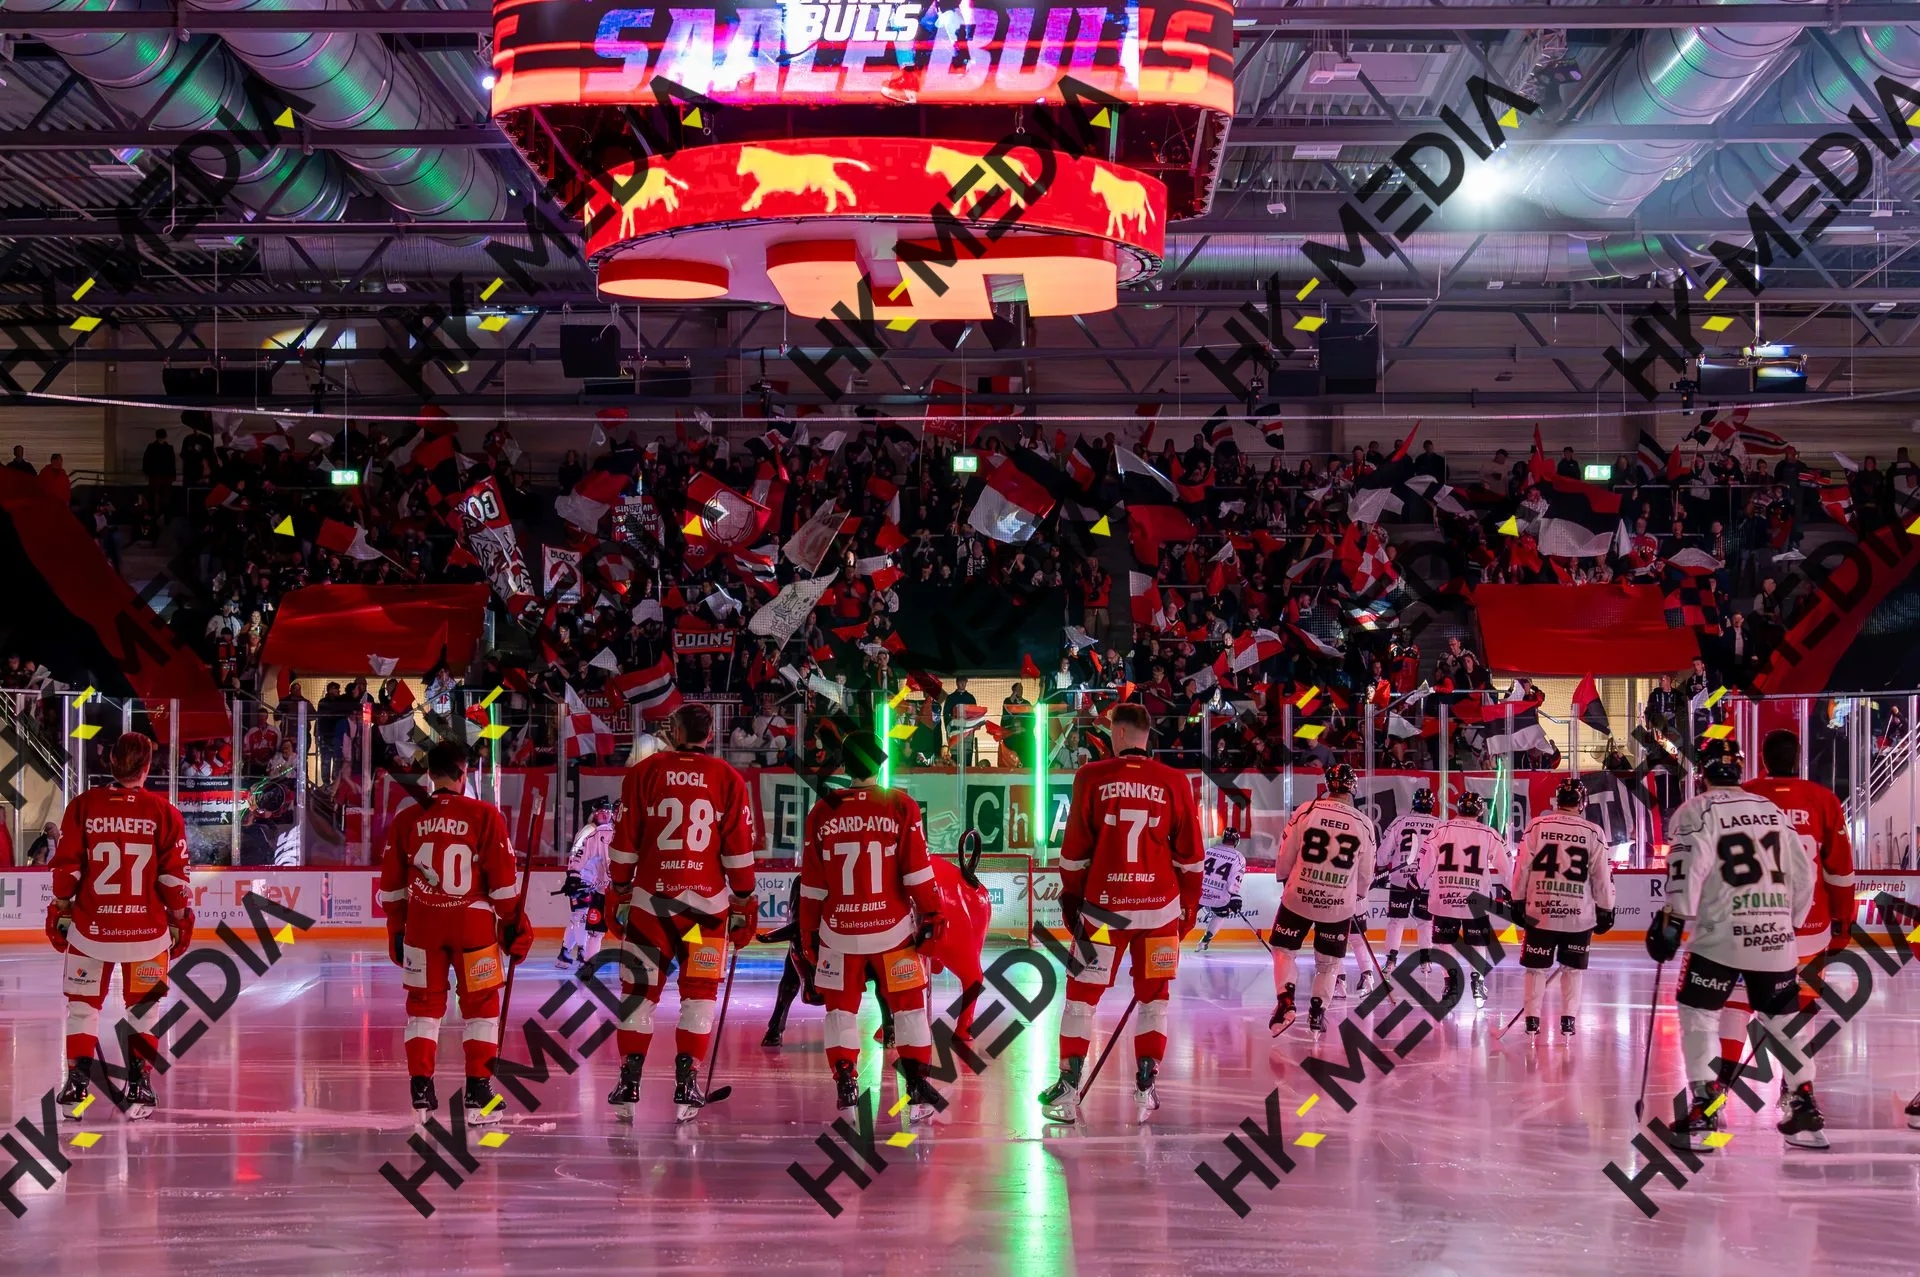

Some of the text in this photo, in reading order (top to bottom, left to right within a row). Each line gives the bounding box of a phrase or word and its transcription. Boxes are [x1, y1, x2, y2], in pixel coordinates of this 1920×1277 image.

[800, 4, 922, 41] BULLS
[675, 631, 733, 648] GOONS
[666, 771, 708, 788] ROGL
[1098, 782, 1167, 804] ZERNIKEL
[416, 817, 469, 837] HUARD
[656, 797, 714, 852] 28
[1320, 818, 1350, 831] REED
[1720, 814, 1779, 829] LAGACE
[1119, 808, 1149, 863] 7
[1541, 831, 1587, 844] HERZOG
[1301, 827, 1361, 870] 83
[92, 841, 153, 896] 27
[833, 841, 883, 896] 71
[1203, 857, 1233, 881] 44
[1437, 842, 1485, 876] 11
[1531, 843, 1589, 883] 43
[1717, 831, 1786, 888] 81
[1111, 895, 1167, 905] Saalesparkasse
[1296, 886, 1326, 898] BLACK
[1301, 895, 1345, 906] DRAGONS
[1535, 899, 1562, 908] BLACK
[102, 927, 158, 936] Saalesparkasse
[840, 917, 896, 929] Saalesparkasse
[1733, 922, 1777, 936] BLACK
[1690, 971, 1731, 992] TecArt
